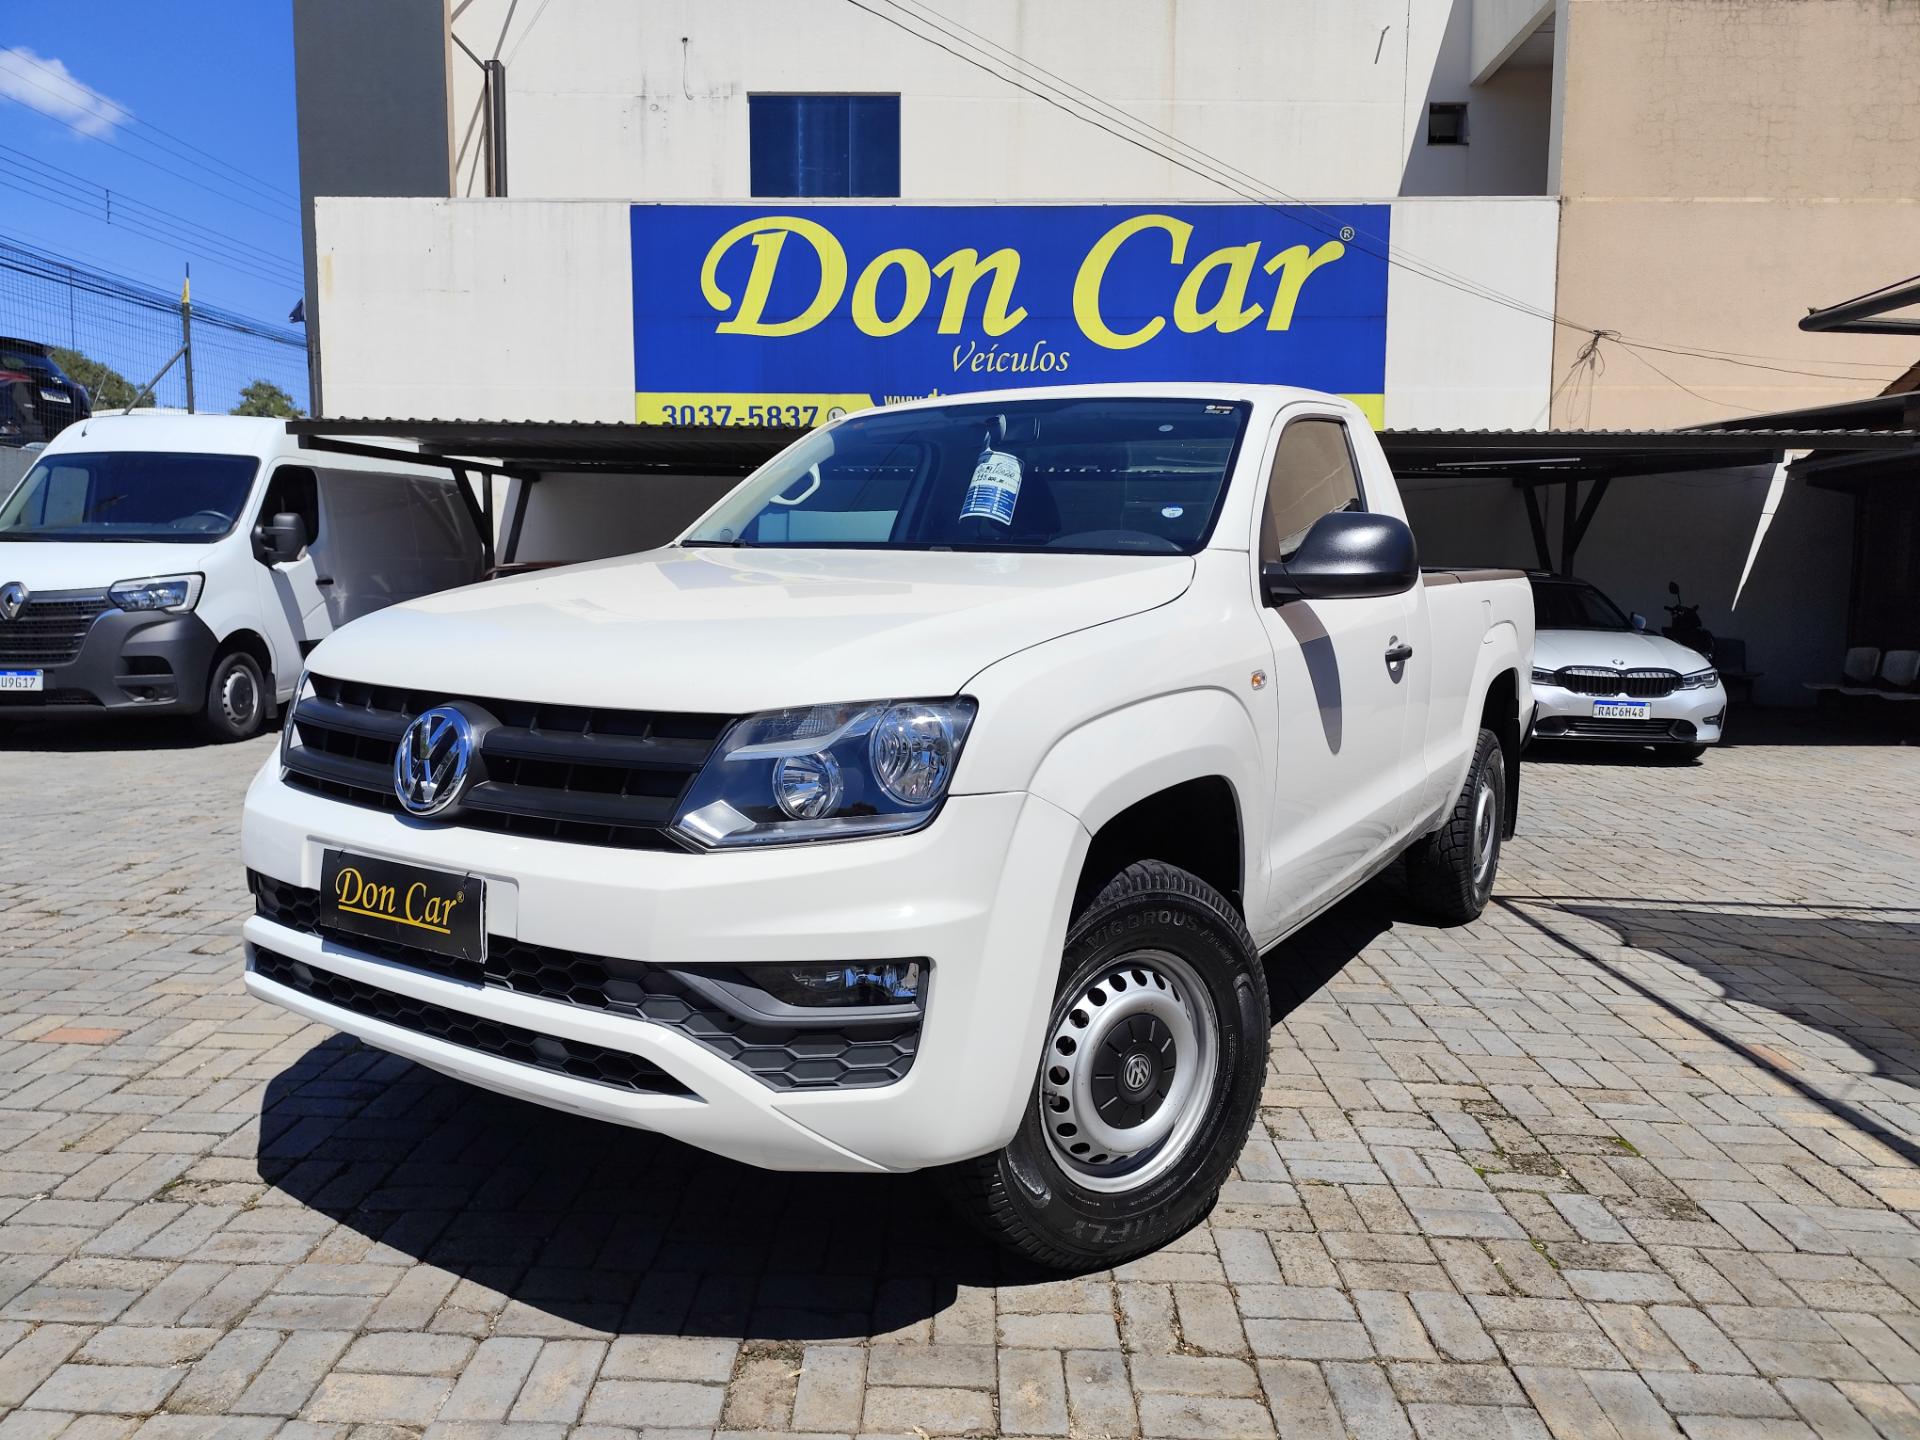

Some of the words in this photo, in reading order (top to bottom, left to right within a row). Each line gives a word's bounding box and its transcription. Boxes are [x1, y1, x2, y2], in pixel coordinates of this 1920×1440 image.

[701, 215, 1029, 337] Don
[1072, 214, 1346, 351] Car
[952, 340, 1070, 372] Veículos
[661, 404, 819, 428] 3037-5837
[1598, 706, 1645, 718] RAC6H48
[335, 867, 396, 914] Don
[405, 882, 457, 926] Car
